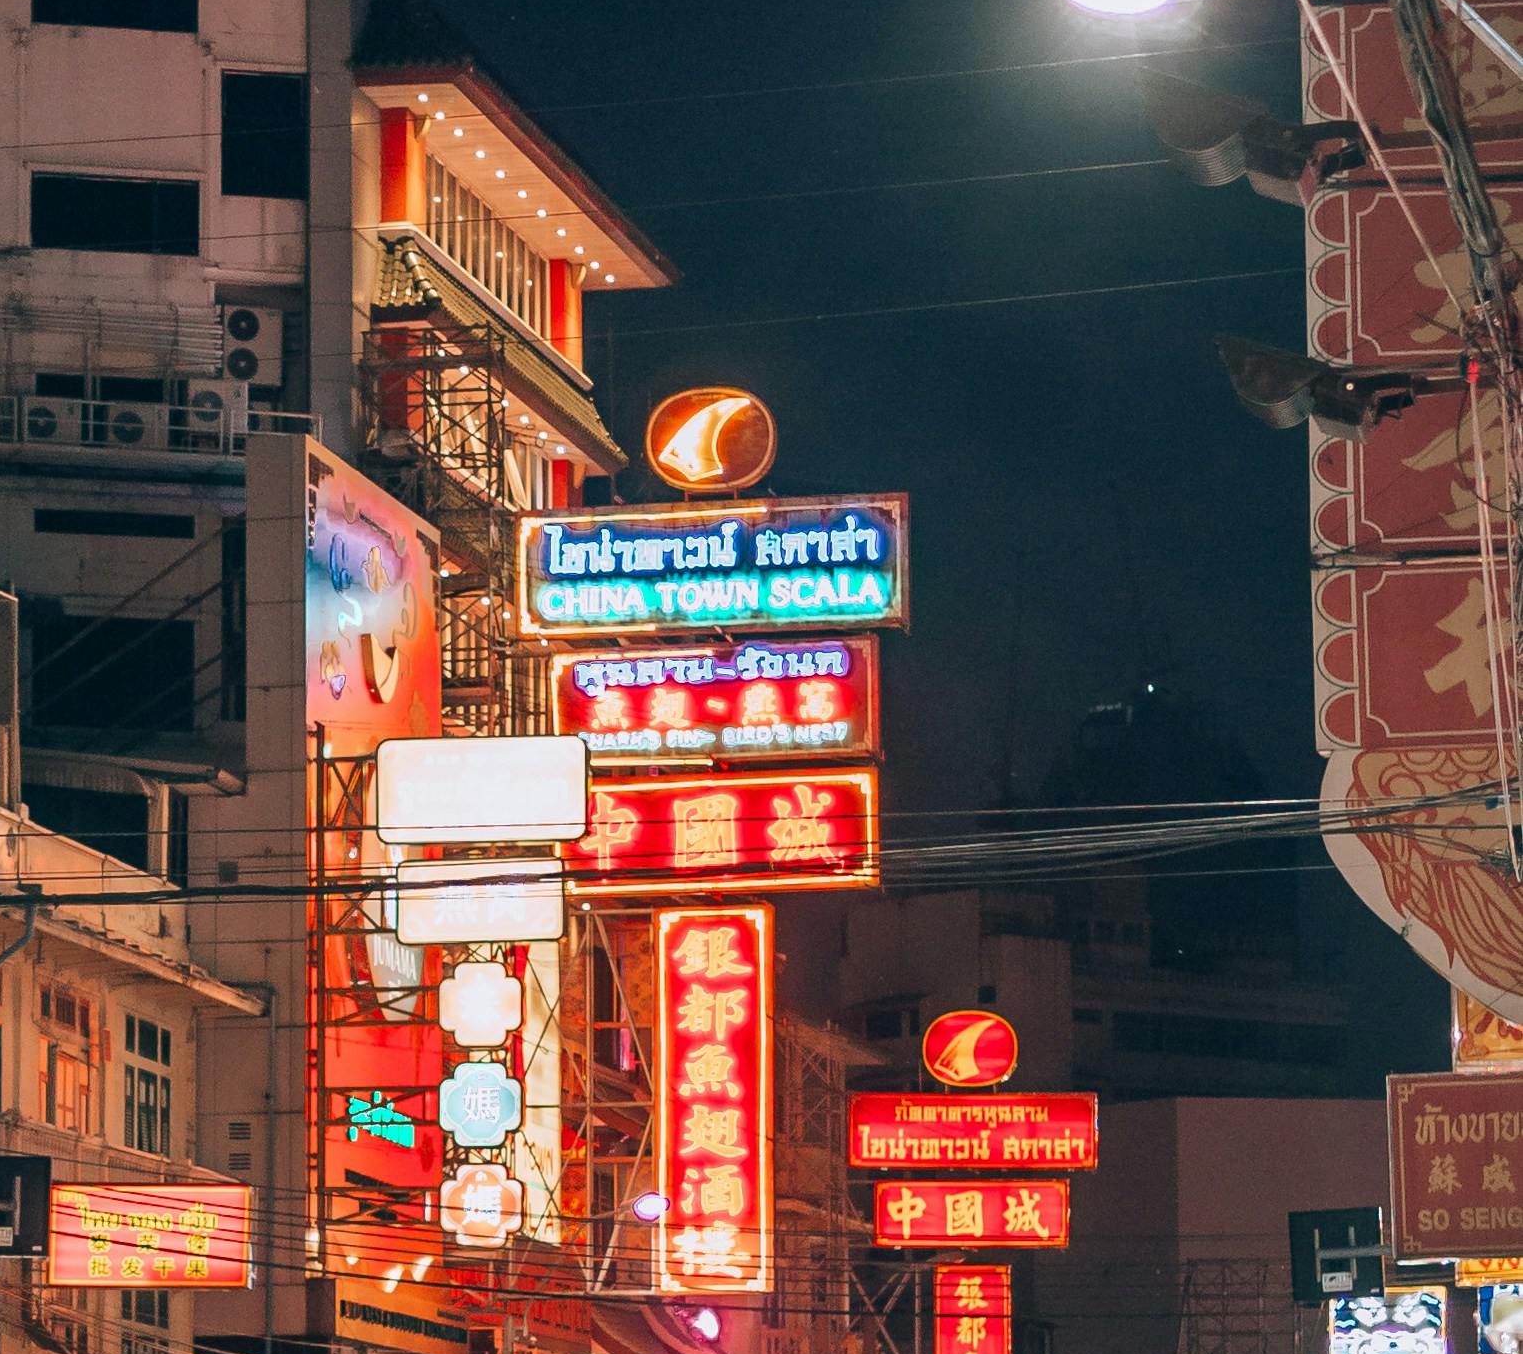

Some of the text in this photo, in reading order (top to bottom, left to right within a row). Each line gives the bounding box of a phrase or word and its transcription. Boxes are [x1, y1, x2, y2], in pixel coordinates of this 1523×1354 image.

[544, 515, 879, 575] ไชน่าทาวน์ สกาล่า
[540, 574, 882, 616] CHINA TOWN SCALA
[580, 785, 836, 870] 中國城
[858, 1124, 1086, 1160] ไชน่าทาวน์ สกาล่า
[1414, 1103, 1523, 1145] ห้างขาย
[887, 1187, 1049, 1240] 中國城
[1418, 1206, 1523, 1232] SO SENG
[88, 1255, 208, 1278] 批发干果
